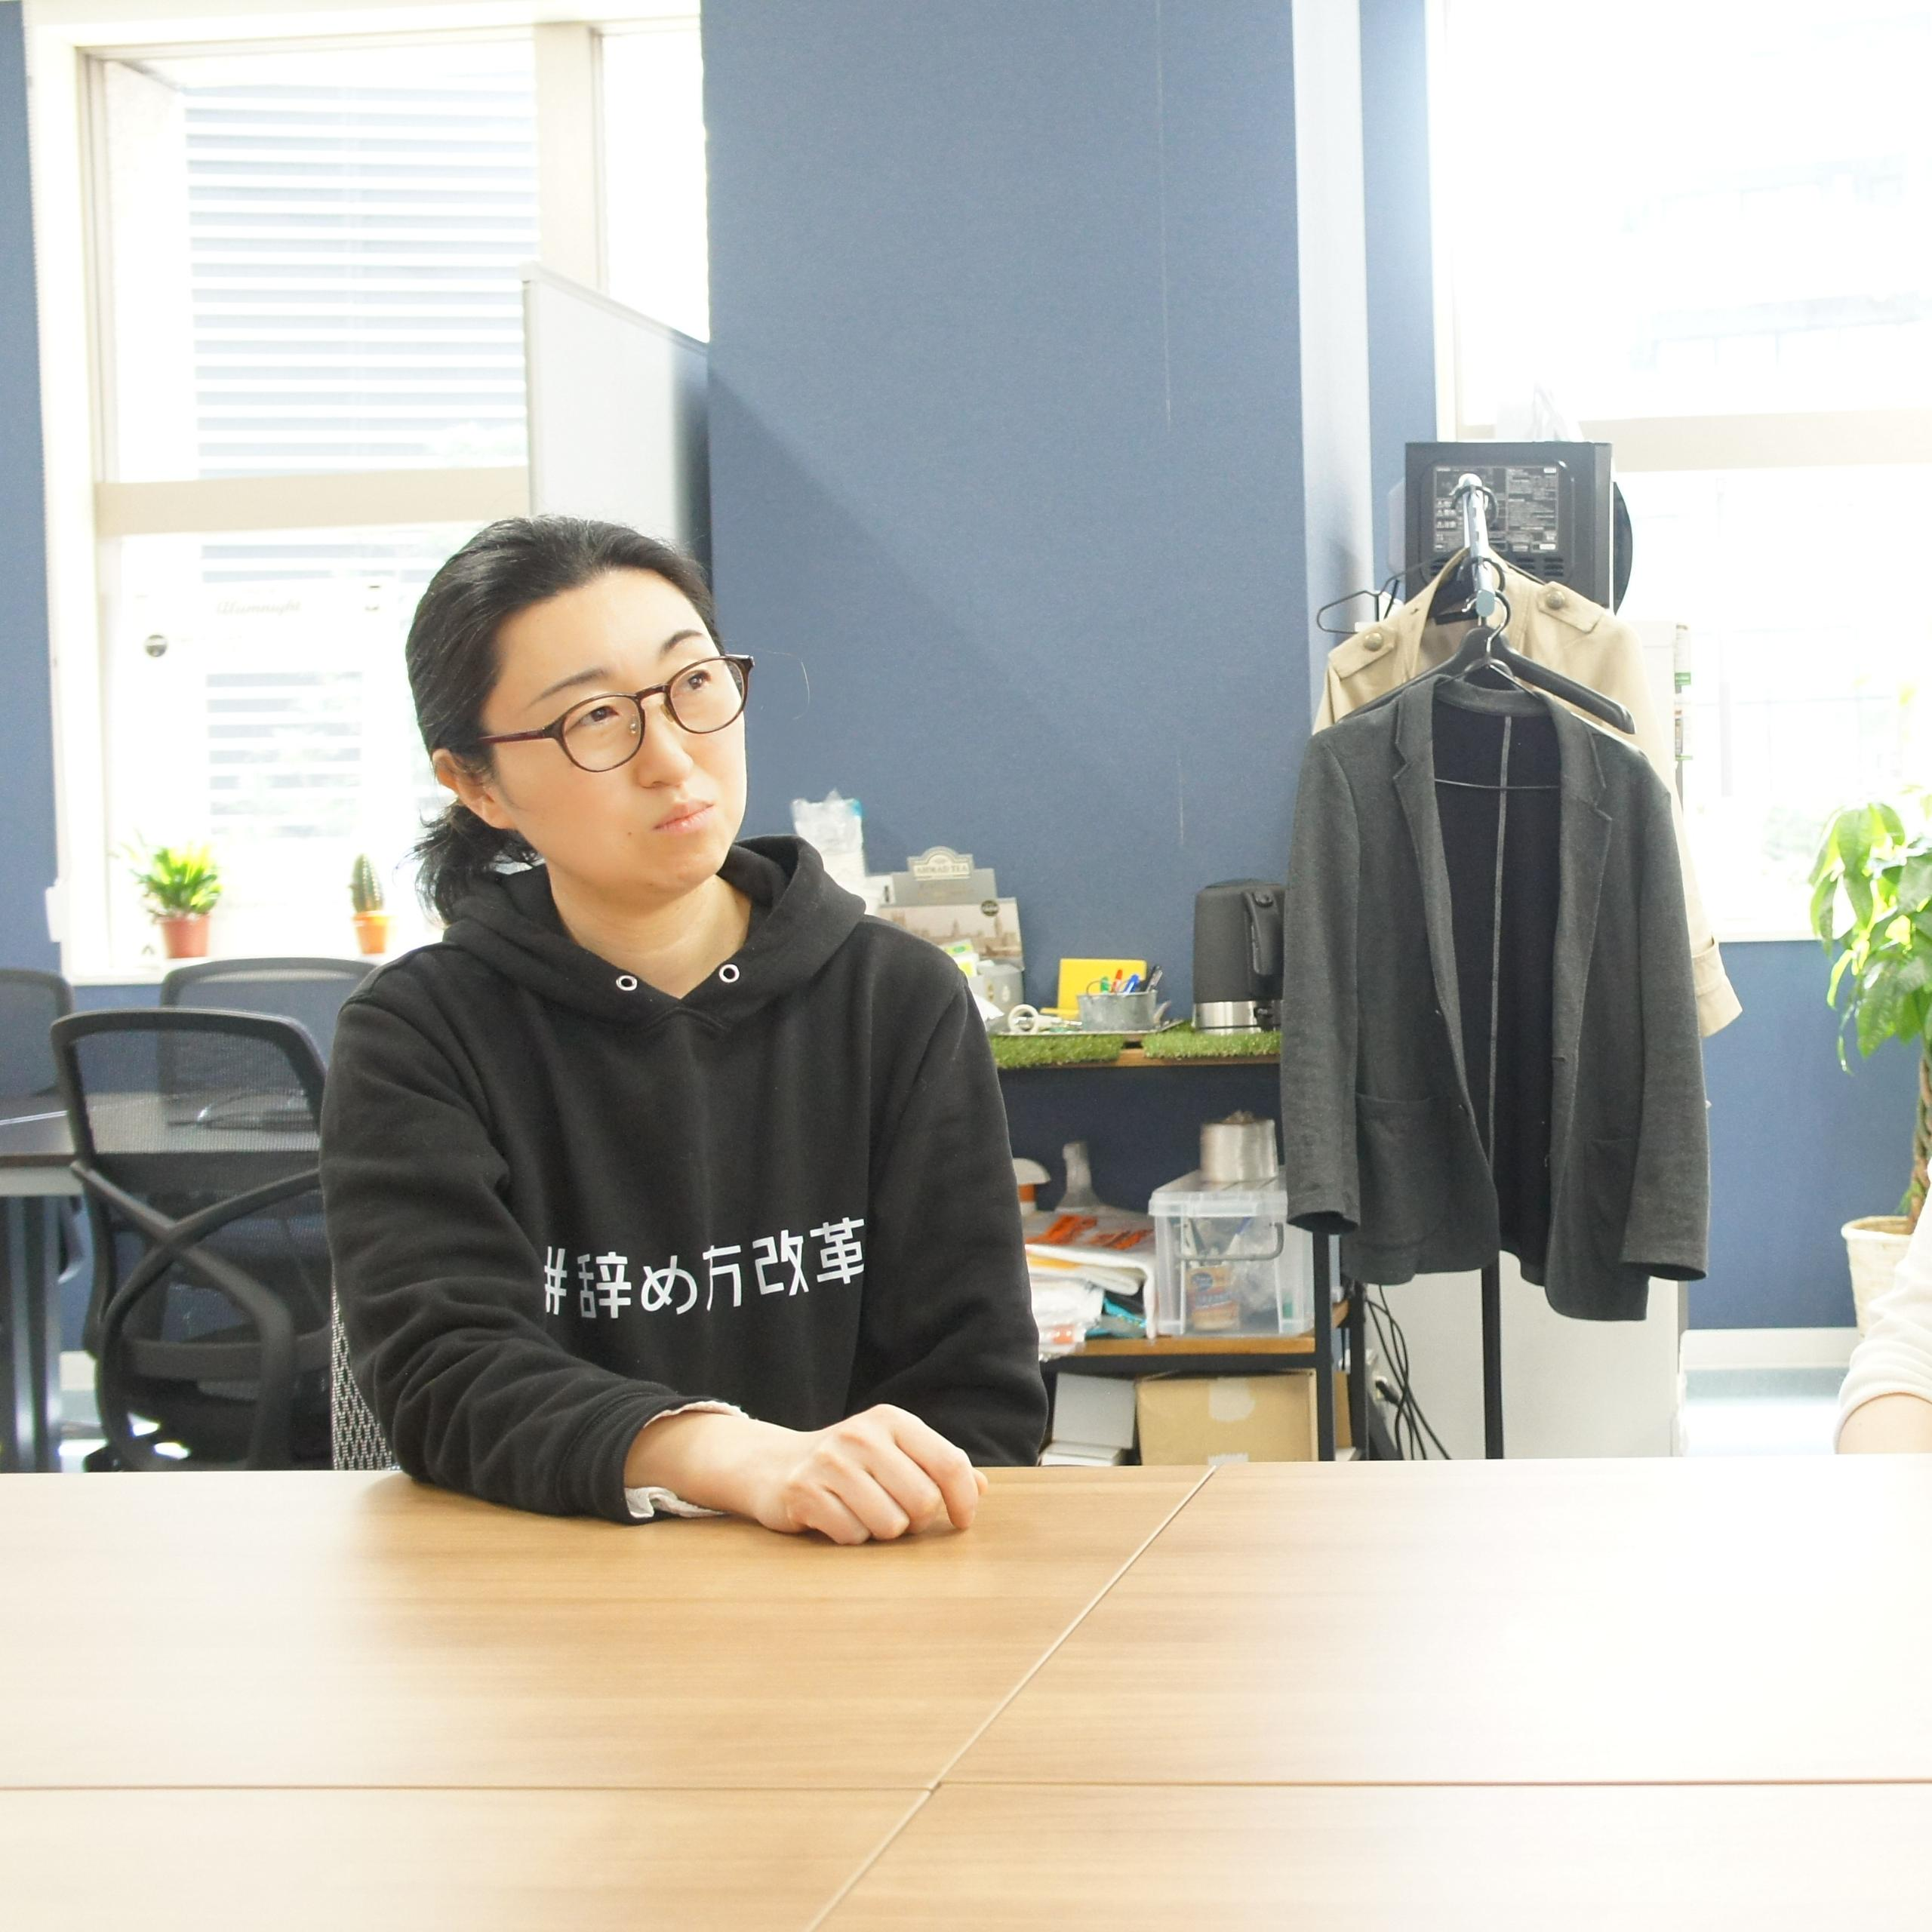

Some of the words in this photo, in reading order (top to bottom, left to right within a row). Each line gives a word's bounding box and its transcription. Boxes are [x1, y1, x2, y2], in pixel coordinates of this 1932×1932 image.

[544, 1217, 865, 1319] #辞め方改革
